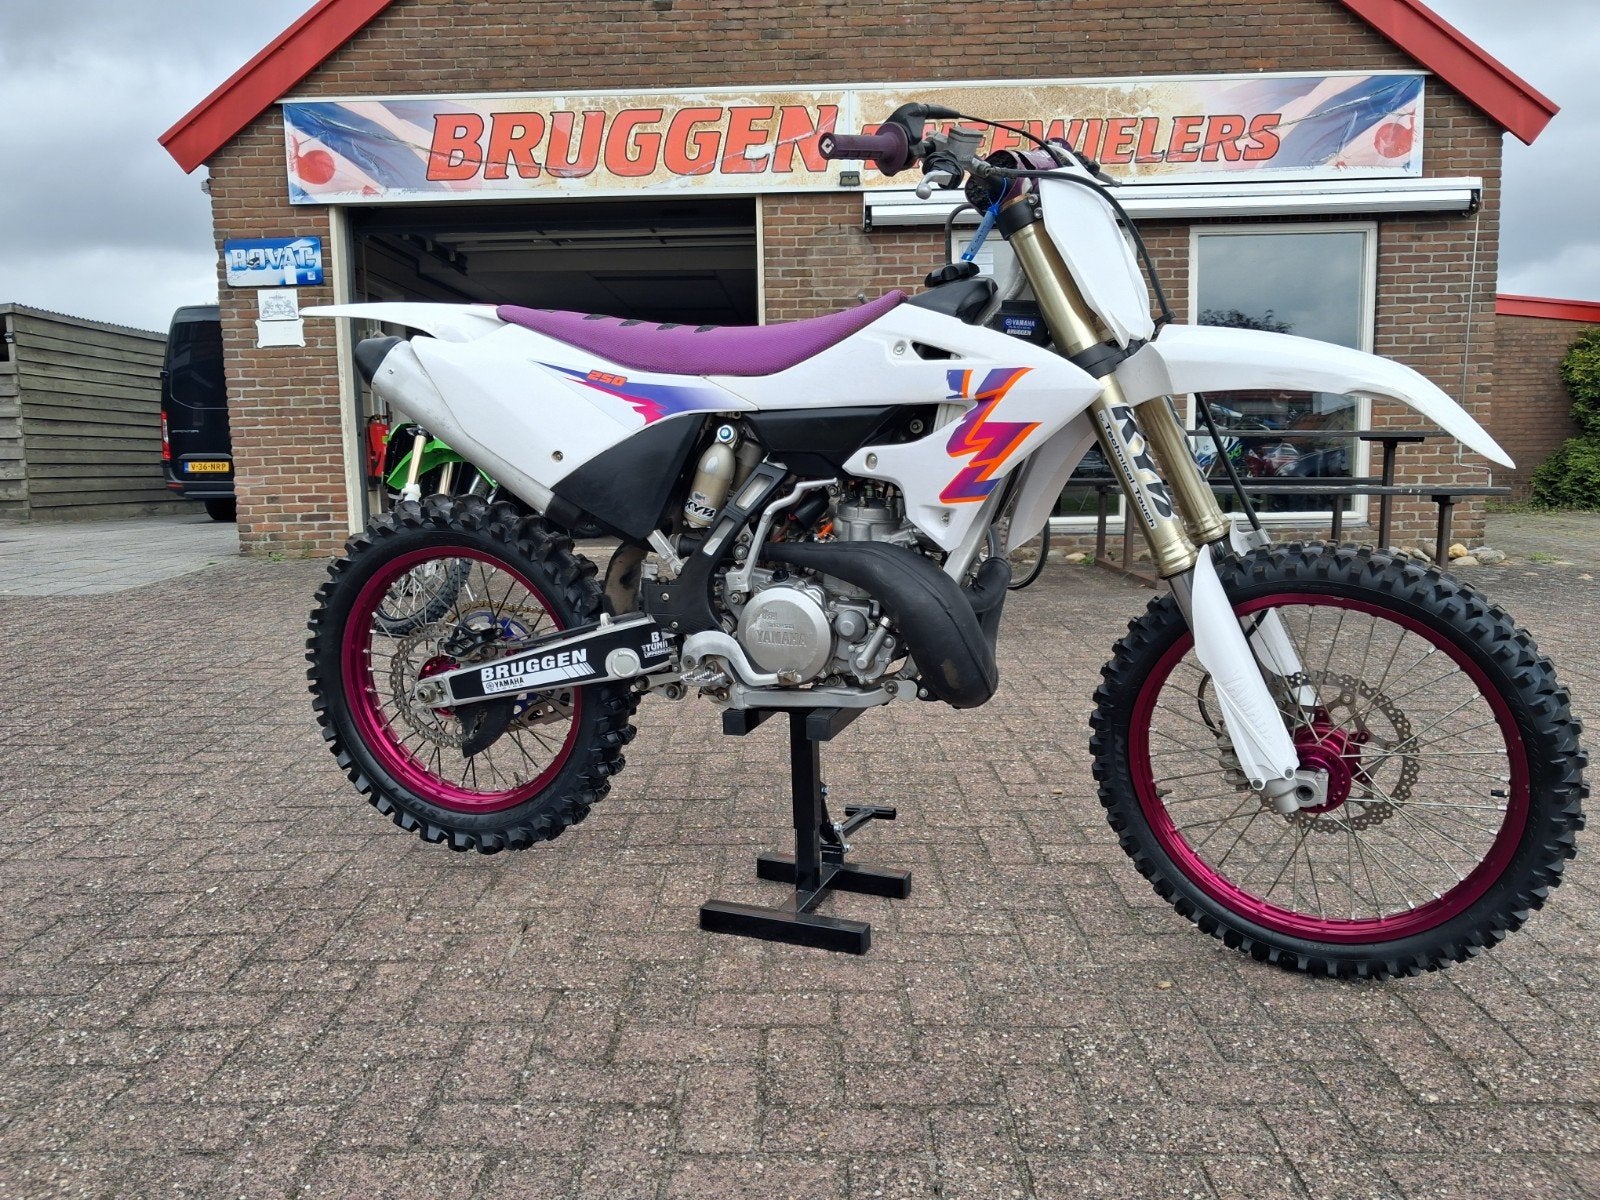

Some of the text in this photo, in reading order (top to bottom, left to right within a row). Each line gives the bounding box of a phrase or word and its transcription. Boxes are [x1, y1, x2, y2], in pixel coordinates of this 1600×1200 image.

[426, 104, 1282, 181] BRUGGEN EWIELERS
[229, 247, 316, 271] BOVAG
[587, 369, 627, 387] 250
[190, 463, 227, 471] V-36-NRP
[1104, 422, 1136, 484] Technical
[1134, 487, 1156, 528] Touch
[1111, 405, 1173, 518] KYB
[481, 649, 587, 682] BRUGGEN
[494, 676, 525, 689] YAMAHA
